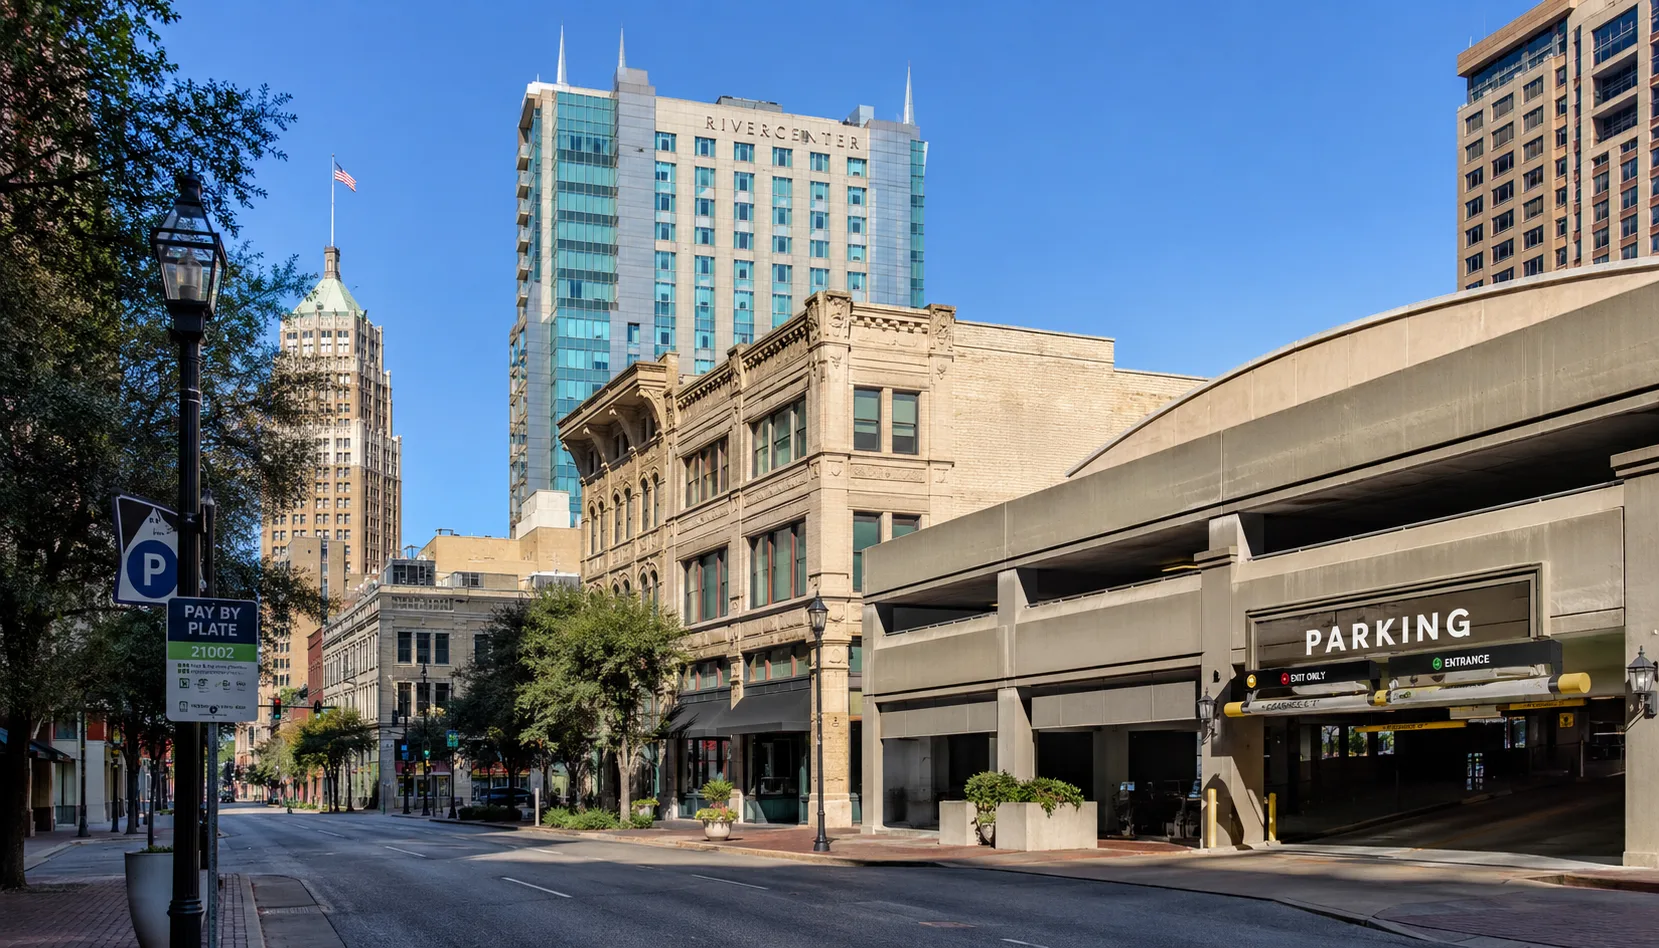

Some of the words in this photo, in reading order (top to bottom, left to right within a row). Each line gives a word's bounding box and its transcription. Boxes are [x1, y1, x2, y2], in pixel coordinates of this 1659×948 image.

[705, 116, 859, 150] RIVERCENTER
[143, 552, 167, 587] P
[184, 604, 215, 619] PAY
[220, 606, 241, 620] BY
[188, 621, 238, 637] PLATE
[1305, 608, 1471, 655] PARKING
[191, 645, 234, 659] 21002
[1444, 654, 1490, 668] ENTRANCE
[1307, 671, 1326, 681] ONLY
